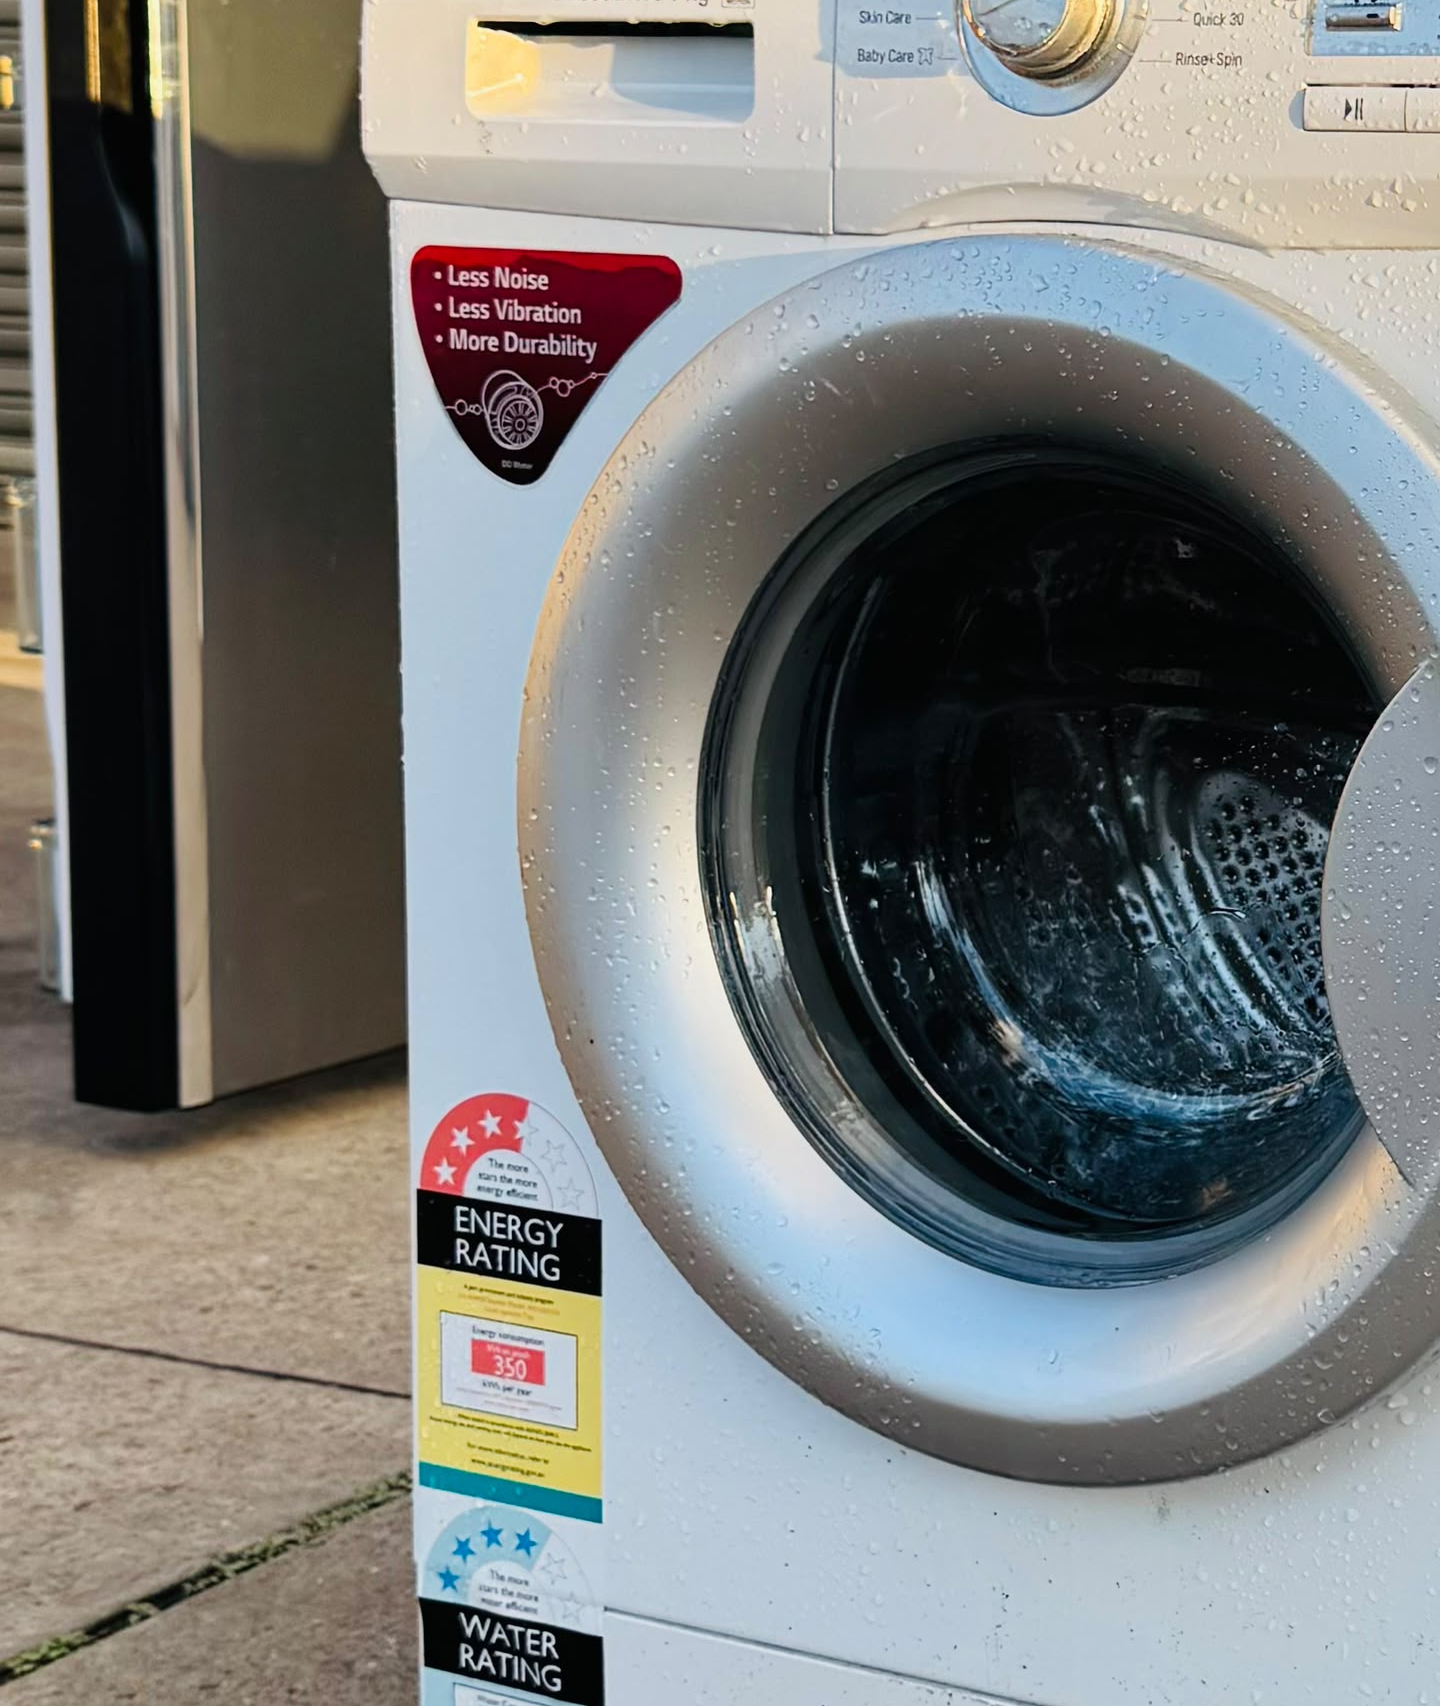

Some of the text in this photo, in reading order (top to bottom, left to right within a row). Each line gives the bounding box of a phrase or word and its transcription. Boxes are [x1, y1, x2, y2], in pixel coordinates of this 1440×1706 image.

[859, 10, 911, 24] Skin Care
[1193, 12, 1244, 26] Quick 30
[857, 48, 914, 64] Baby Care
[447, 264, 549, 291] Less Noise
[448, 296, 582, 325] Less Vibration
[449, 327, 598, 364] More Durability
[488, 1158, 529, 1173] The more
[477, 1185, 503, 1198] energy
[478, 1172, 538, 1188] stars the more
[454, 1204, 564, 1249] ENERGY
[454, 1237, 561, 1282] RATING
[492, 1354, 528, 1381] 350
[459, 1611, 559, 1660] WATER
[459, 1642, 562, 1692] RATING
